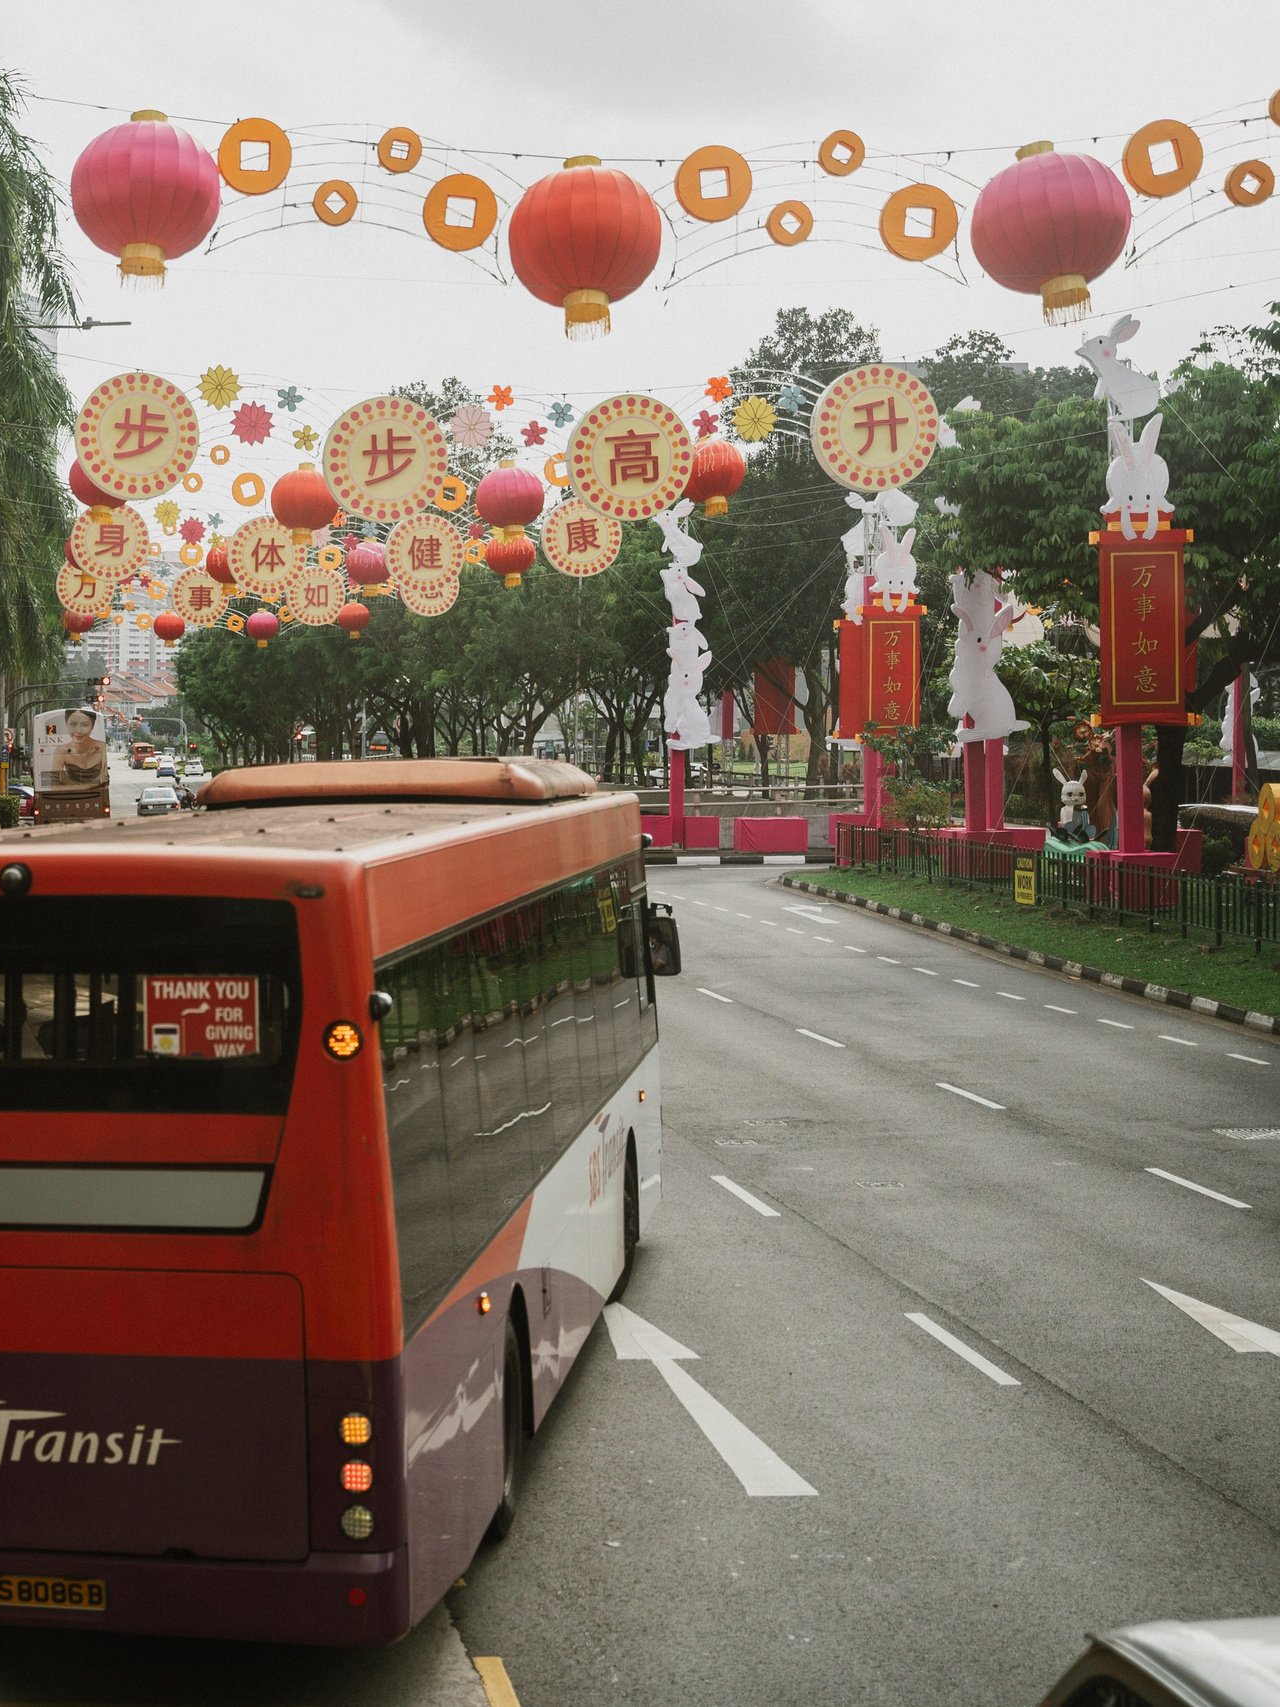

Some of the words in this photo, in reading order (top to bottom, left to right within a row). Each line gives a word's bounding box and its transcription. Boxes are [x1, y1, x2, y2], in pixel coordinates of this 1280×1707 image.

[113, 404, 169, 459] 步
[362, 428, 416, 486] 步
[604, 429, 660, 487] 高
[853, 396, 909, 456] 升
[94, 524, 129, 557] 身
[251, 537, 286, 573] 体
[408, 534, 443, 571] 健
[566, 516, 601, 554] 康
[188, 585, 214, 611] 事
[304, 582, 329, 609] 如
[1131, 565, 1158, 693] 万事如意
[883, 630, 901, 720] 万事如意
[48, 725, 53, 735] 2
[38, 736, 63, 744] LINK
[152, 981, 211, 1000] THANK
[214, 981, 249, 999] YOU
[215, 1008, 243, 1022] FOR
[205, 1026, 254, 1041] GIVING
[213, 1045, 246, 1058] WAY
